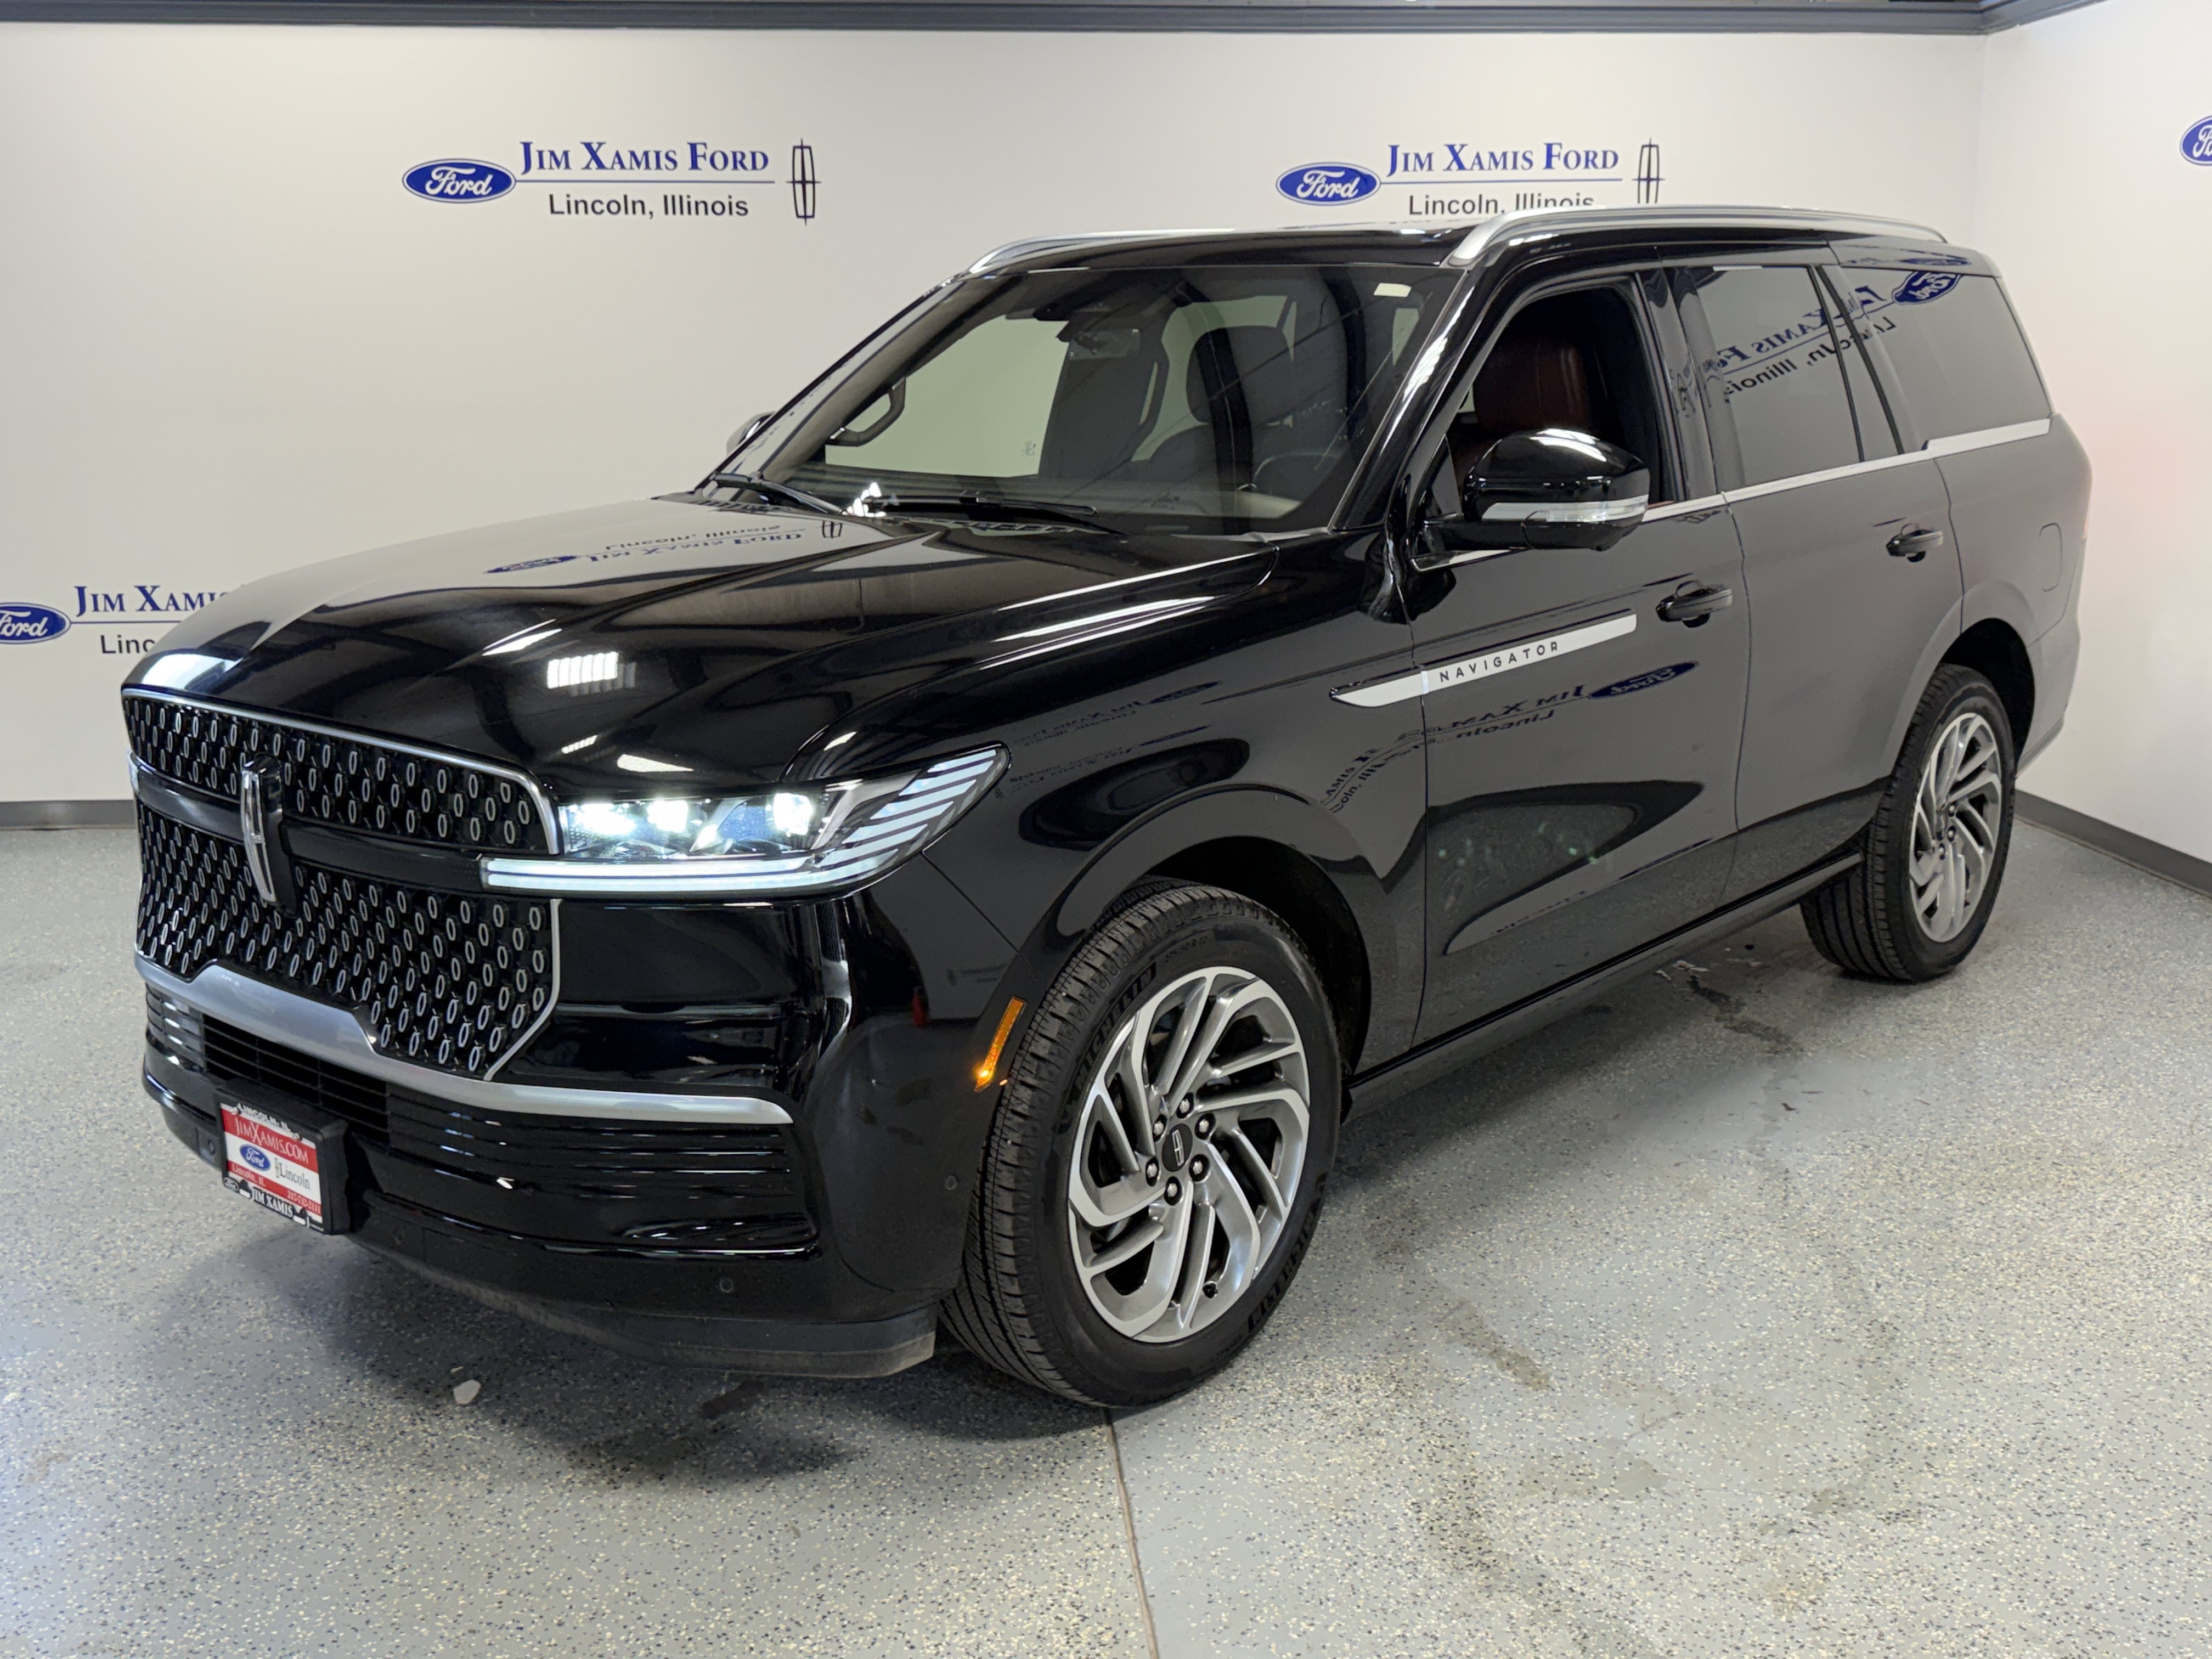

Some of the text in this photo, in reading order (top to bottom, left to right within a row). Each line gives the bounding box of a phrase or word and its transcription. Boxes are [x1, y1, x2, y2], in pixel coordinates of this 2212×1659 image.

[520, 142, 769, 175] JIM XAMIS FORD
[1387, 143, 1619, 177] JIM XAMIS FORD
[425, 165, 493, 196] Ford
[1297, 170, 1359, 198] Ford
[549, 194, 749, 219] Lincoln, Illinois
[75, 585, 229, 617] JIM XAMI
[1440, 640, 1560, 682] NAVIGATOR
[246, 1148, 264, 1167] Ford
[280, 1163, 311, 1189] Lincoln
[251, 1188, 293, 1217] JIM XAMIS
